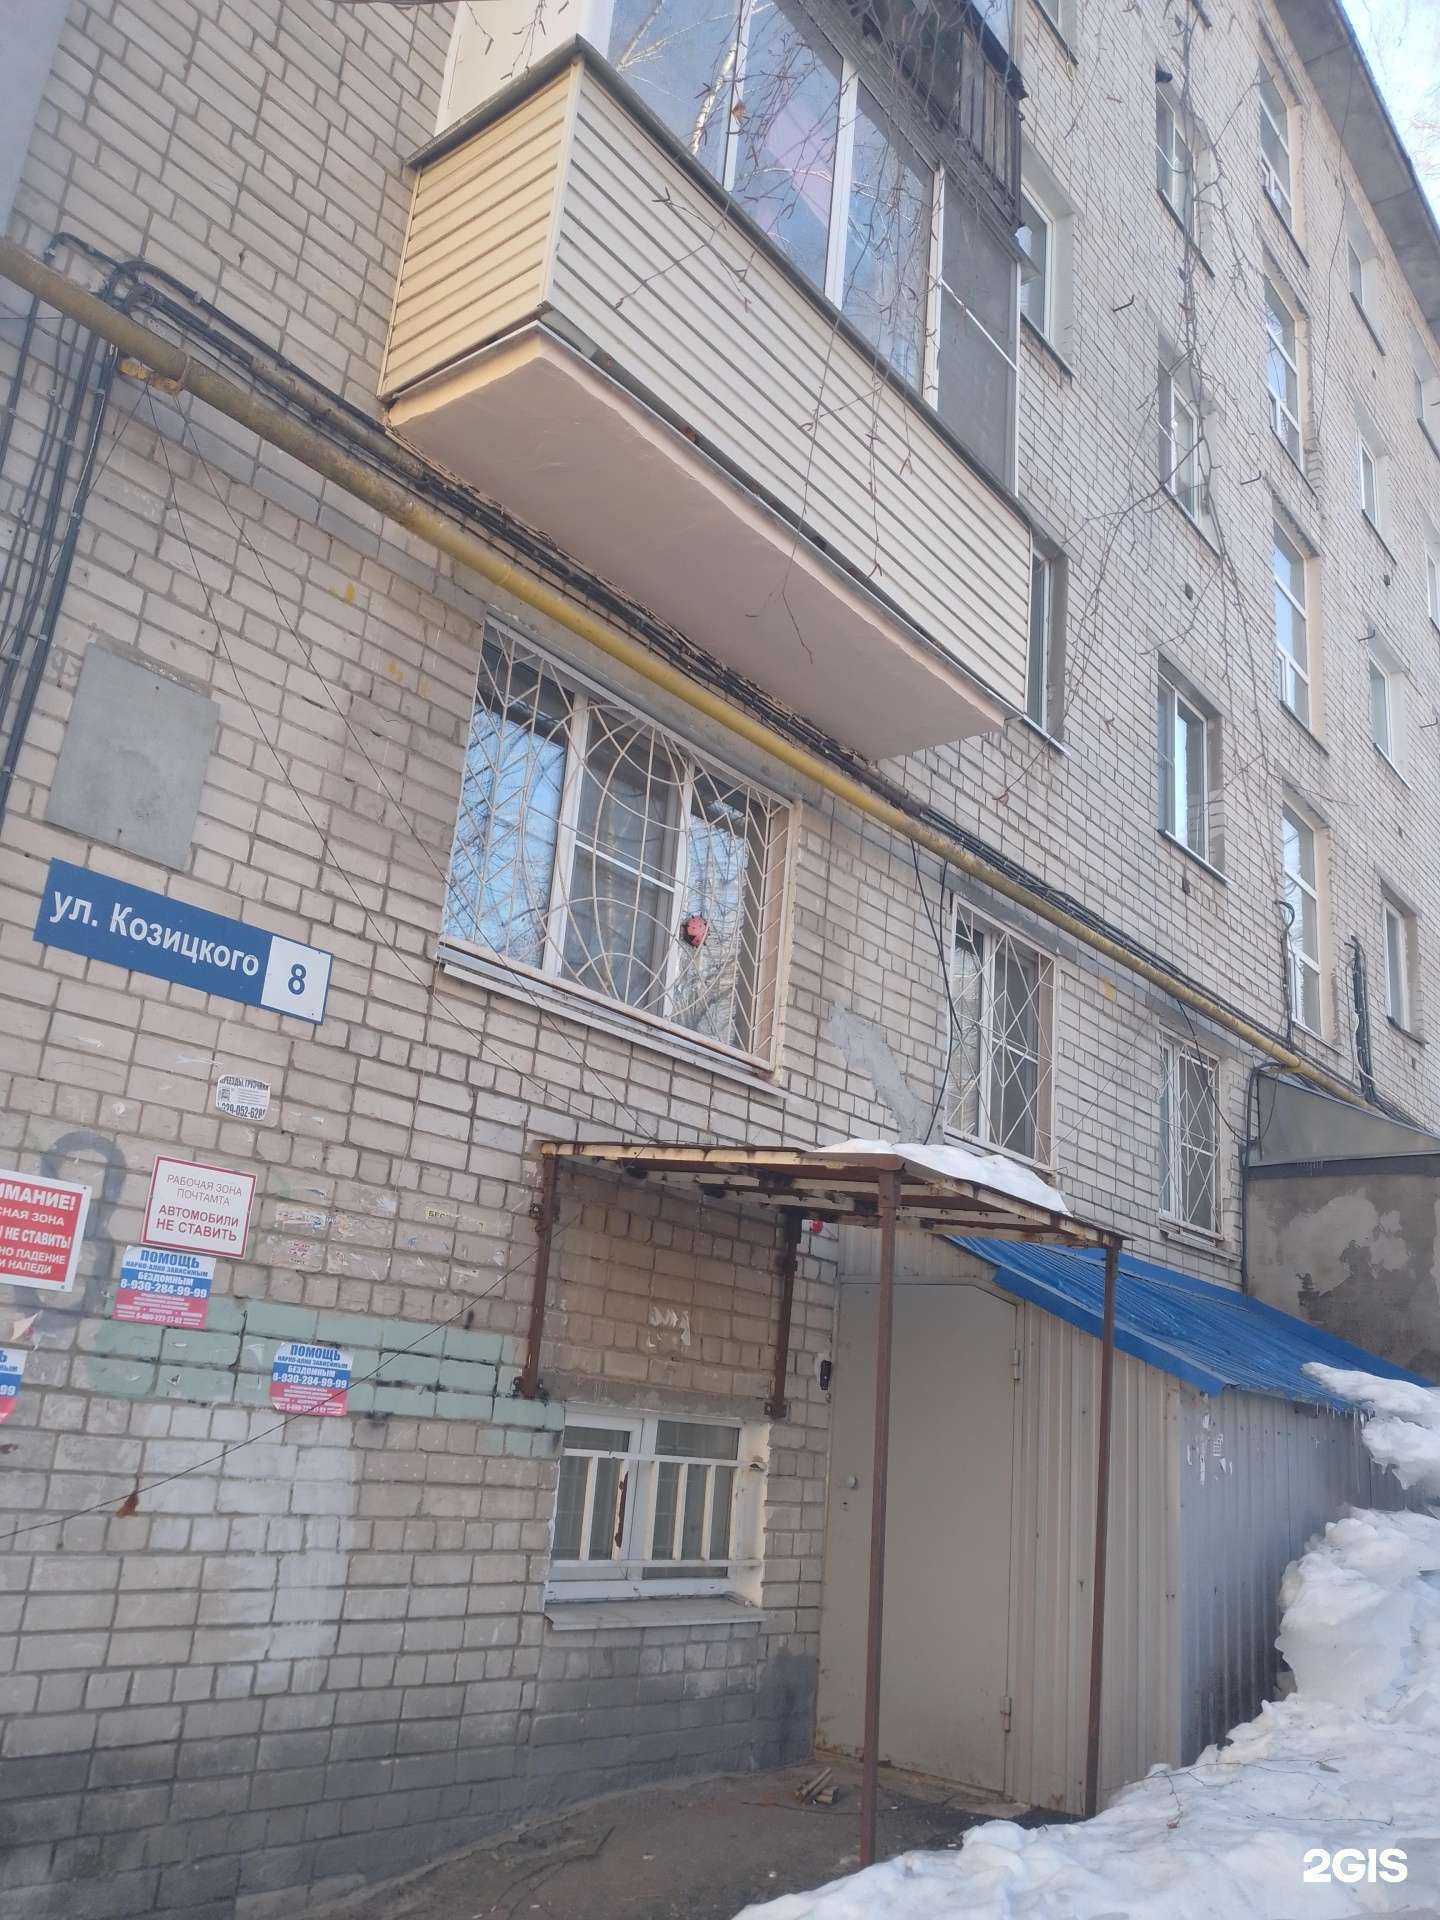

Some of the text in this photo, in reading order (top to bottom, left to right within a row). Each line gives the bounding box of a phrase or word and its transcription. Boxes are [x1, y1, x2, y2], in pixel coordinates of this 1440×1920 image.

[49, 891, 307, 996] ул. Козицкого 8
[167, 1174, 242, 1196] РАБОЧАЯ ЗОНА
[177, 1188, 230, 1207] ПОЧТАМТА
[32, 1212, 65, 1227] ЗОНА
[158, 1204, 239, 1228] АВТОМОБИЛИ
[4, 1226, 21, 1241] НЕ
[21, 1229, 72, 1249] СТАВИТЬ!
[156, 1218, 237, 1242] НЕ СТАВИТЬ
[16, 1248, 66, 1265] ПАДЕНИЕ
[140, 1250, 200, 1269] ПОМОЩЬ
[8, 1259, 52, 1275] НАЛЕДИ
[138, 1271, 194, 1287] БЕЗДОМНЫМ
[290, 1344, 341, 1361] ПОМОЩЬ
[287, 1365, 336, 1378] БЕЗДОМНЫМ
